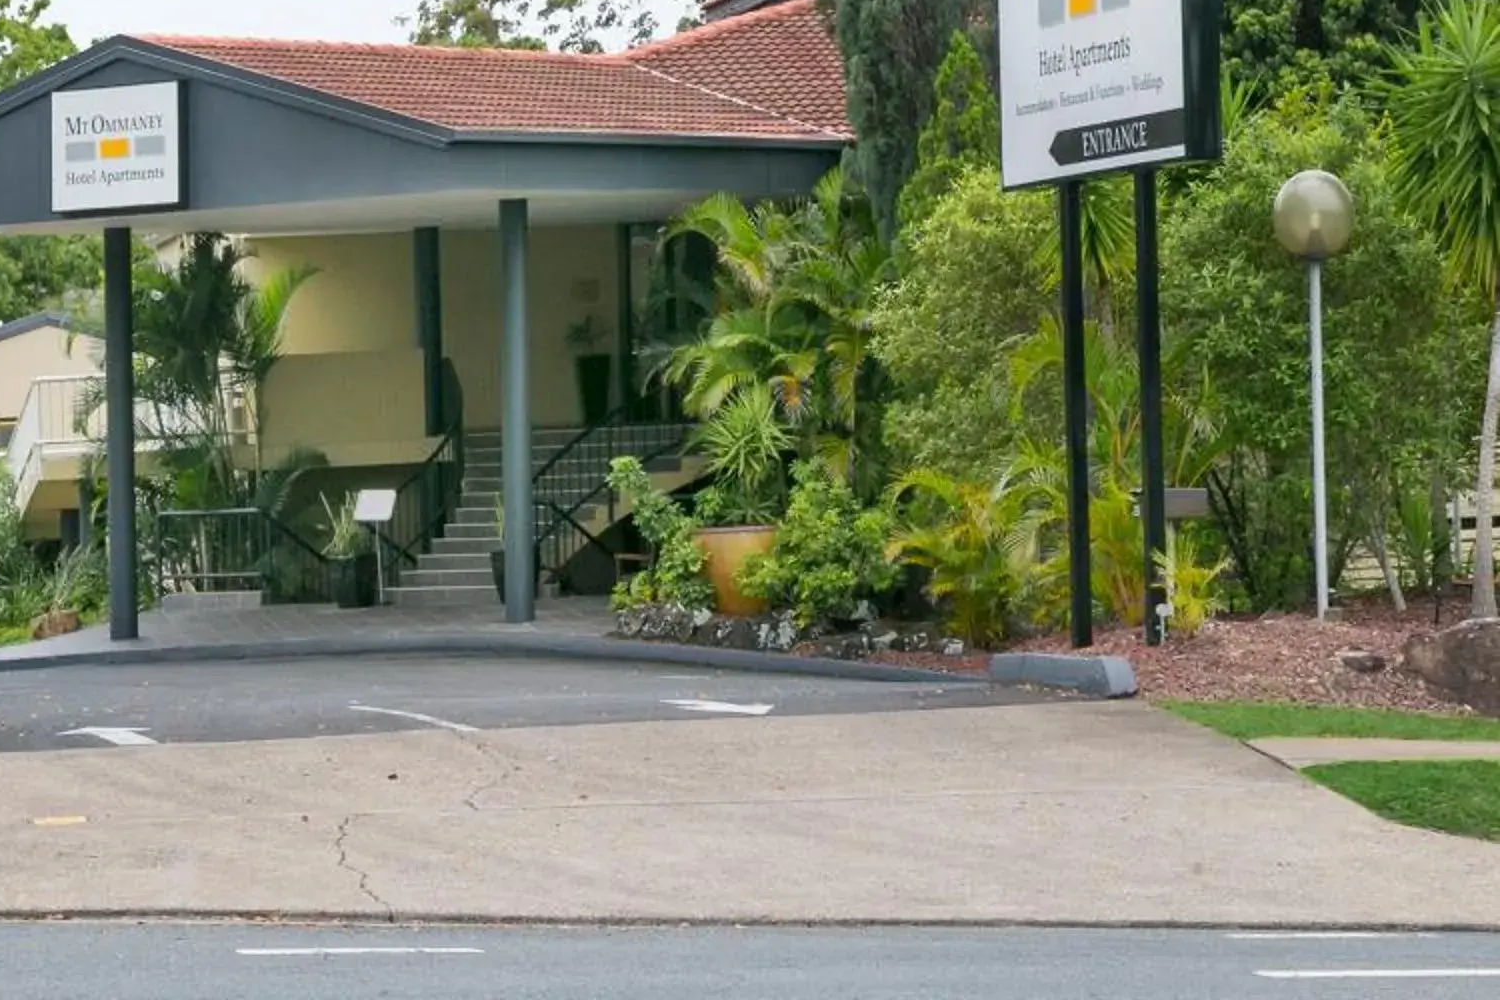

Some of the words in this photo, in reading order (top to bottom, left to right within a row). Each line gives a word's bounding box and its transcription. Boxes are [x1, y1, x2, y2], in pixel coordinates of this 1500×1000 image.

[1039, 43, 1068, 76] Hotel
[1069, 36, 1131, 77] Apartments
[91, 113, 163, 134] OMMANEY
[1082, 121, 1147, 157] ENTRANCE
[65, 169, 96, 185] Hotel
[99, 167, 165, 187] Apartments
